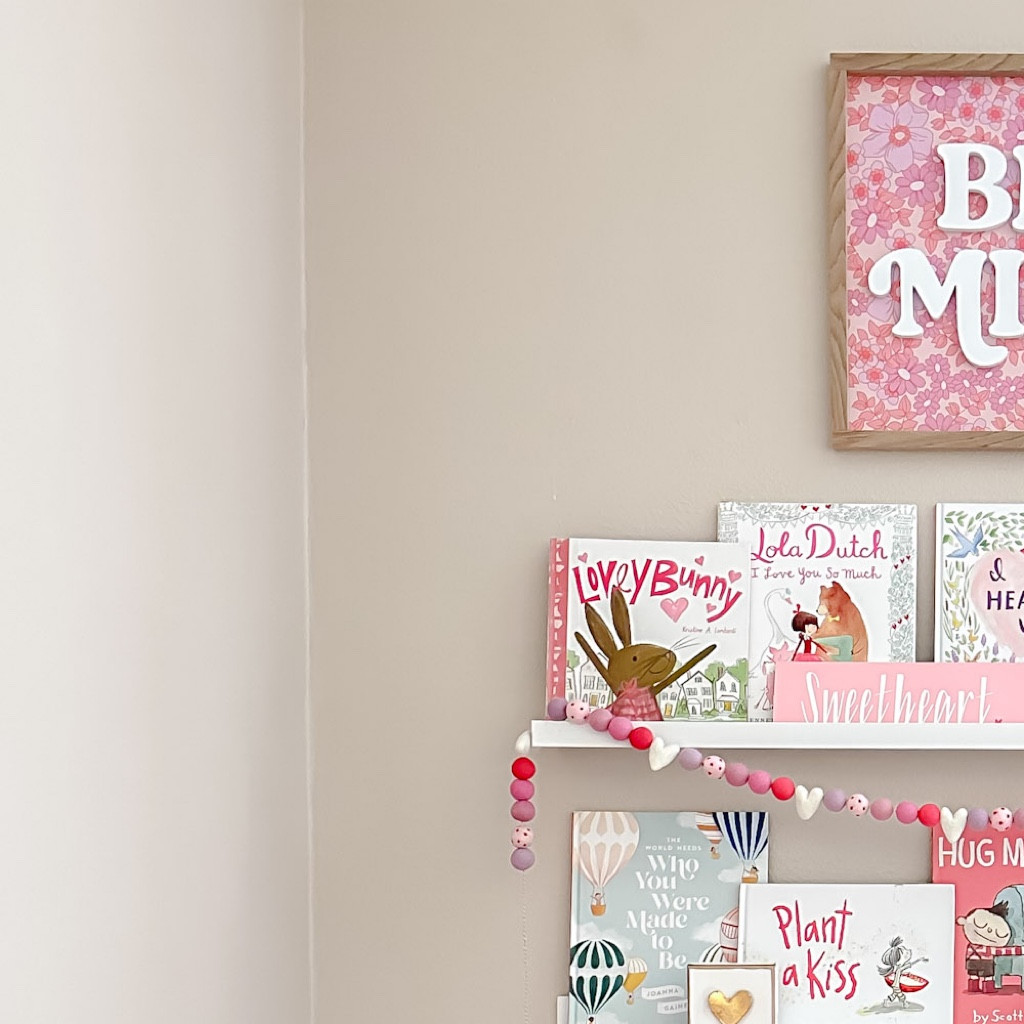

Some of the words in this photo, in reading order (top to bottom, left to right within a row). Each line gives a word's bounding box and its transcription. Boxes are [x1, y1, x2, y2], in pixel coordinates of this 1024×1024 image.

[751, 527, 803, 563] Lola
[805, 523, 888, 559] Dutch
[764, 566, 794, 579] Love
[826, 566, 839, 579] So
[841, 566, 882, 579] Much
[989, 557, 1006, 582] I
[800, 671, 994, 723] Sweetheart
[938, 836, 995, 868] HUG
[647, 854, 699, 881] Who
[635, 871, 677, 890] You
[651, 893, 710, 910] Were
[626, 910, 688, 936] Made
[772, 899, 853, 950] Plant
[659, 952, 686, 970] Be
[782, 963, 799, 987] a
[807, 948, 860, 1000] Kiss
[647, 987, 679, 997] JOANNA
[991, 1009, 1023, 1022] Scott
